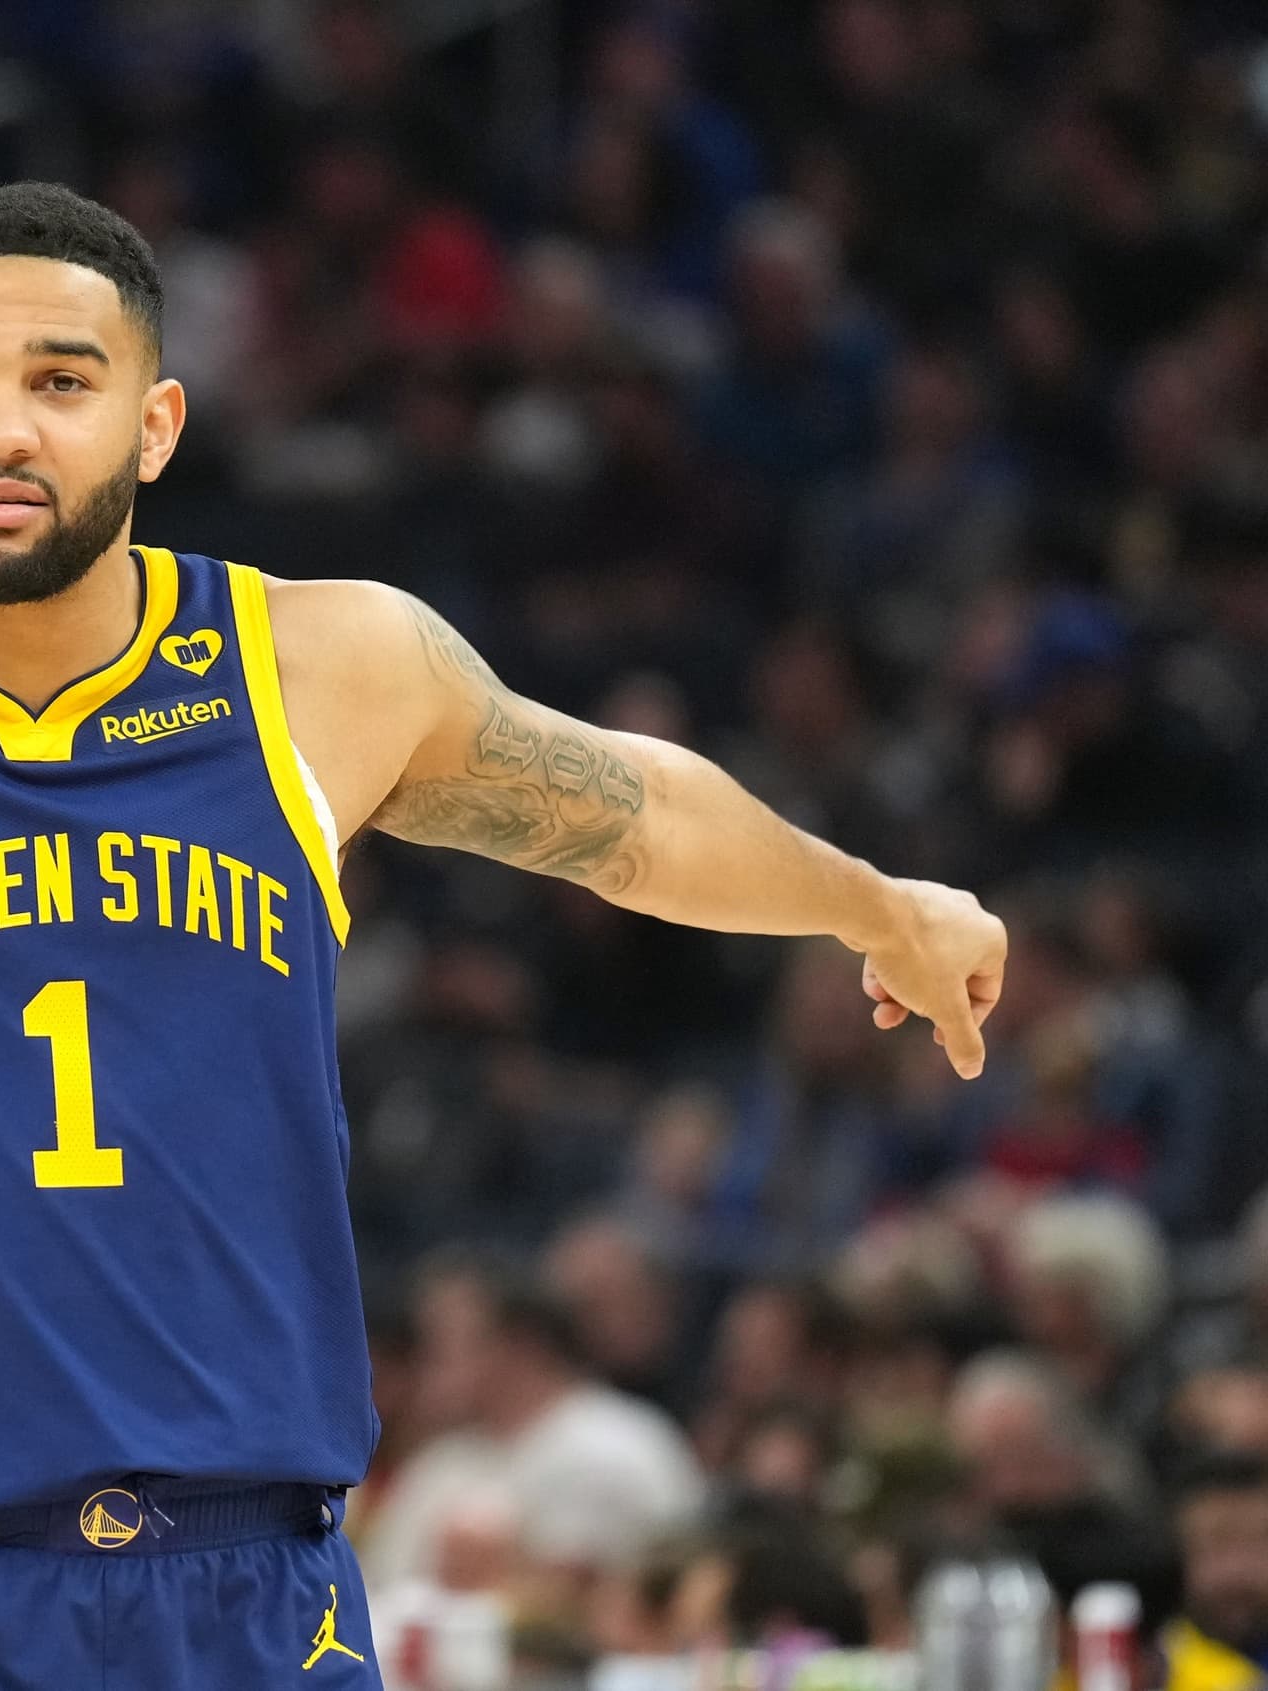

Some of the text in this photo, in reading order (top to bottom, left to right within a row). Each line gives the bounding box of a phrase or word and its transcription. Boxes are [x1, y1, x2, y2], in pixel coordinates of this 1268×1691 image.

[174, 640, 212, 665] DM
[100, 697, 232, 743] Rakuten
[96, 831, 290, 978] STATE
[22, 980, 124, 1189] 1
